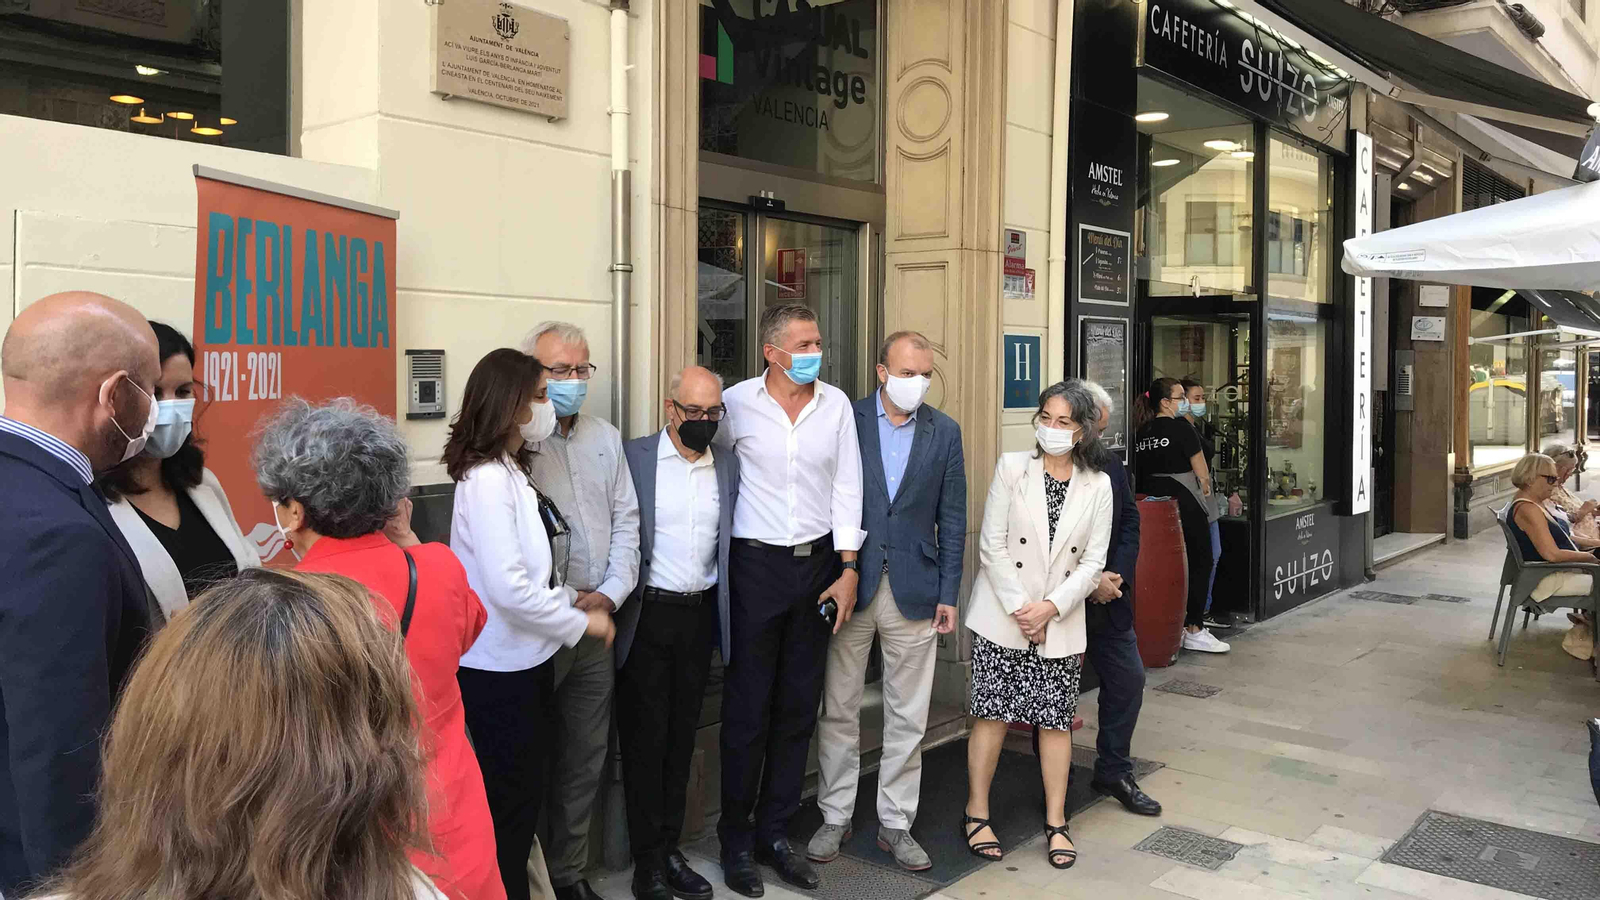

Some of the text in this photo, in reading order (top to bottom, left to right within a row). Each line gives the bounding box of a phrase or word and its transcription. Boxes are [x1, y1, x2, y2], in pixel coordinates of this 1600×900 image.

[463, 44, 478, 54] VIURE
[490, 52, 504, 60] ANYS
[470, 35, 503, 48] AJUNTAMENT
[1151, 4, 1319, 122] CAFETERÍA SUIZO
[442, 69, 468, 80] CINEASTA
[485, 79, 514, 91] CENTENARI
[515, 85, 524, 93] DEL
[496, 94, 520, 104] OCTUBRE
[752, 93, 829, 130] VALENCIA
[1088, 162, 1122, 186] AMSTEL
[204, 212, 389, 348] BERLANGA
[1014, 343, 1031, 380] H
[1296, 514, 1314, 530] AMSTEL
[1274, 549, 1333, 599] SUIZO
